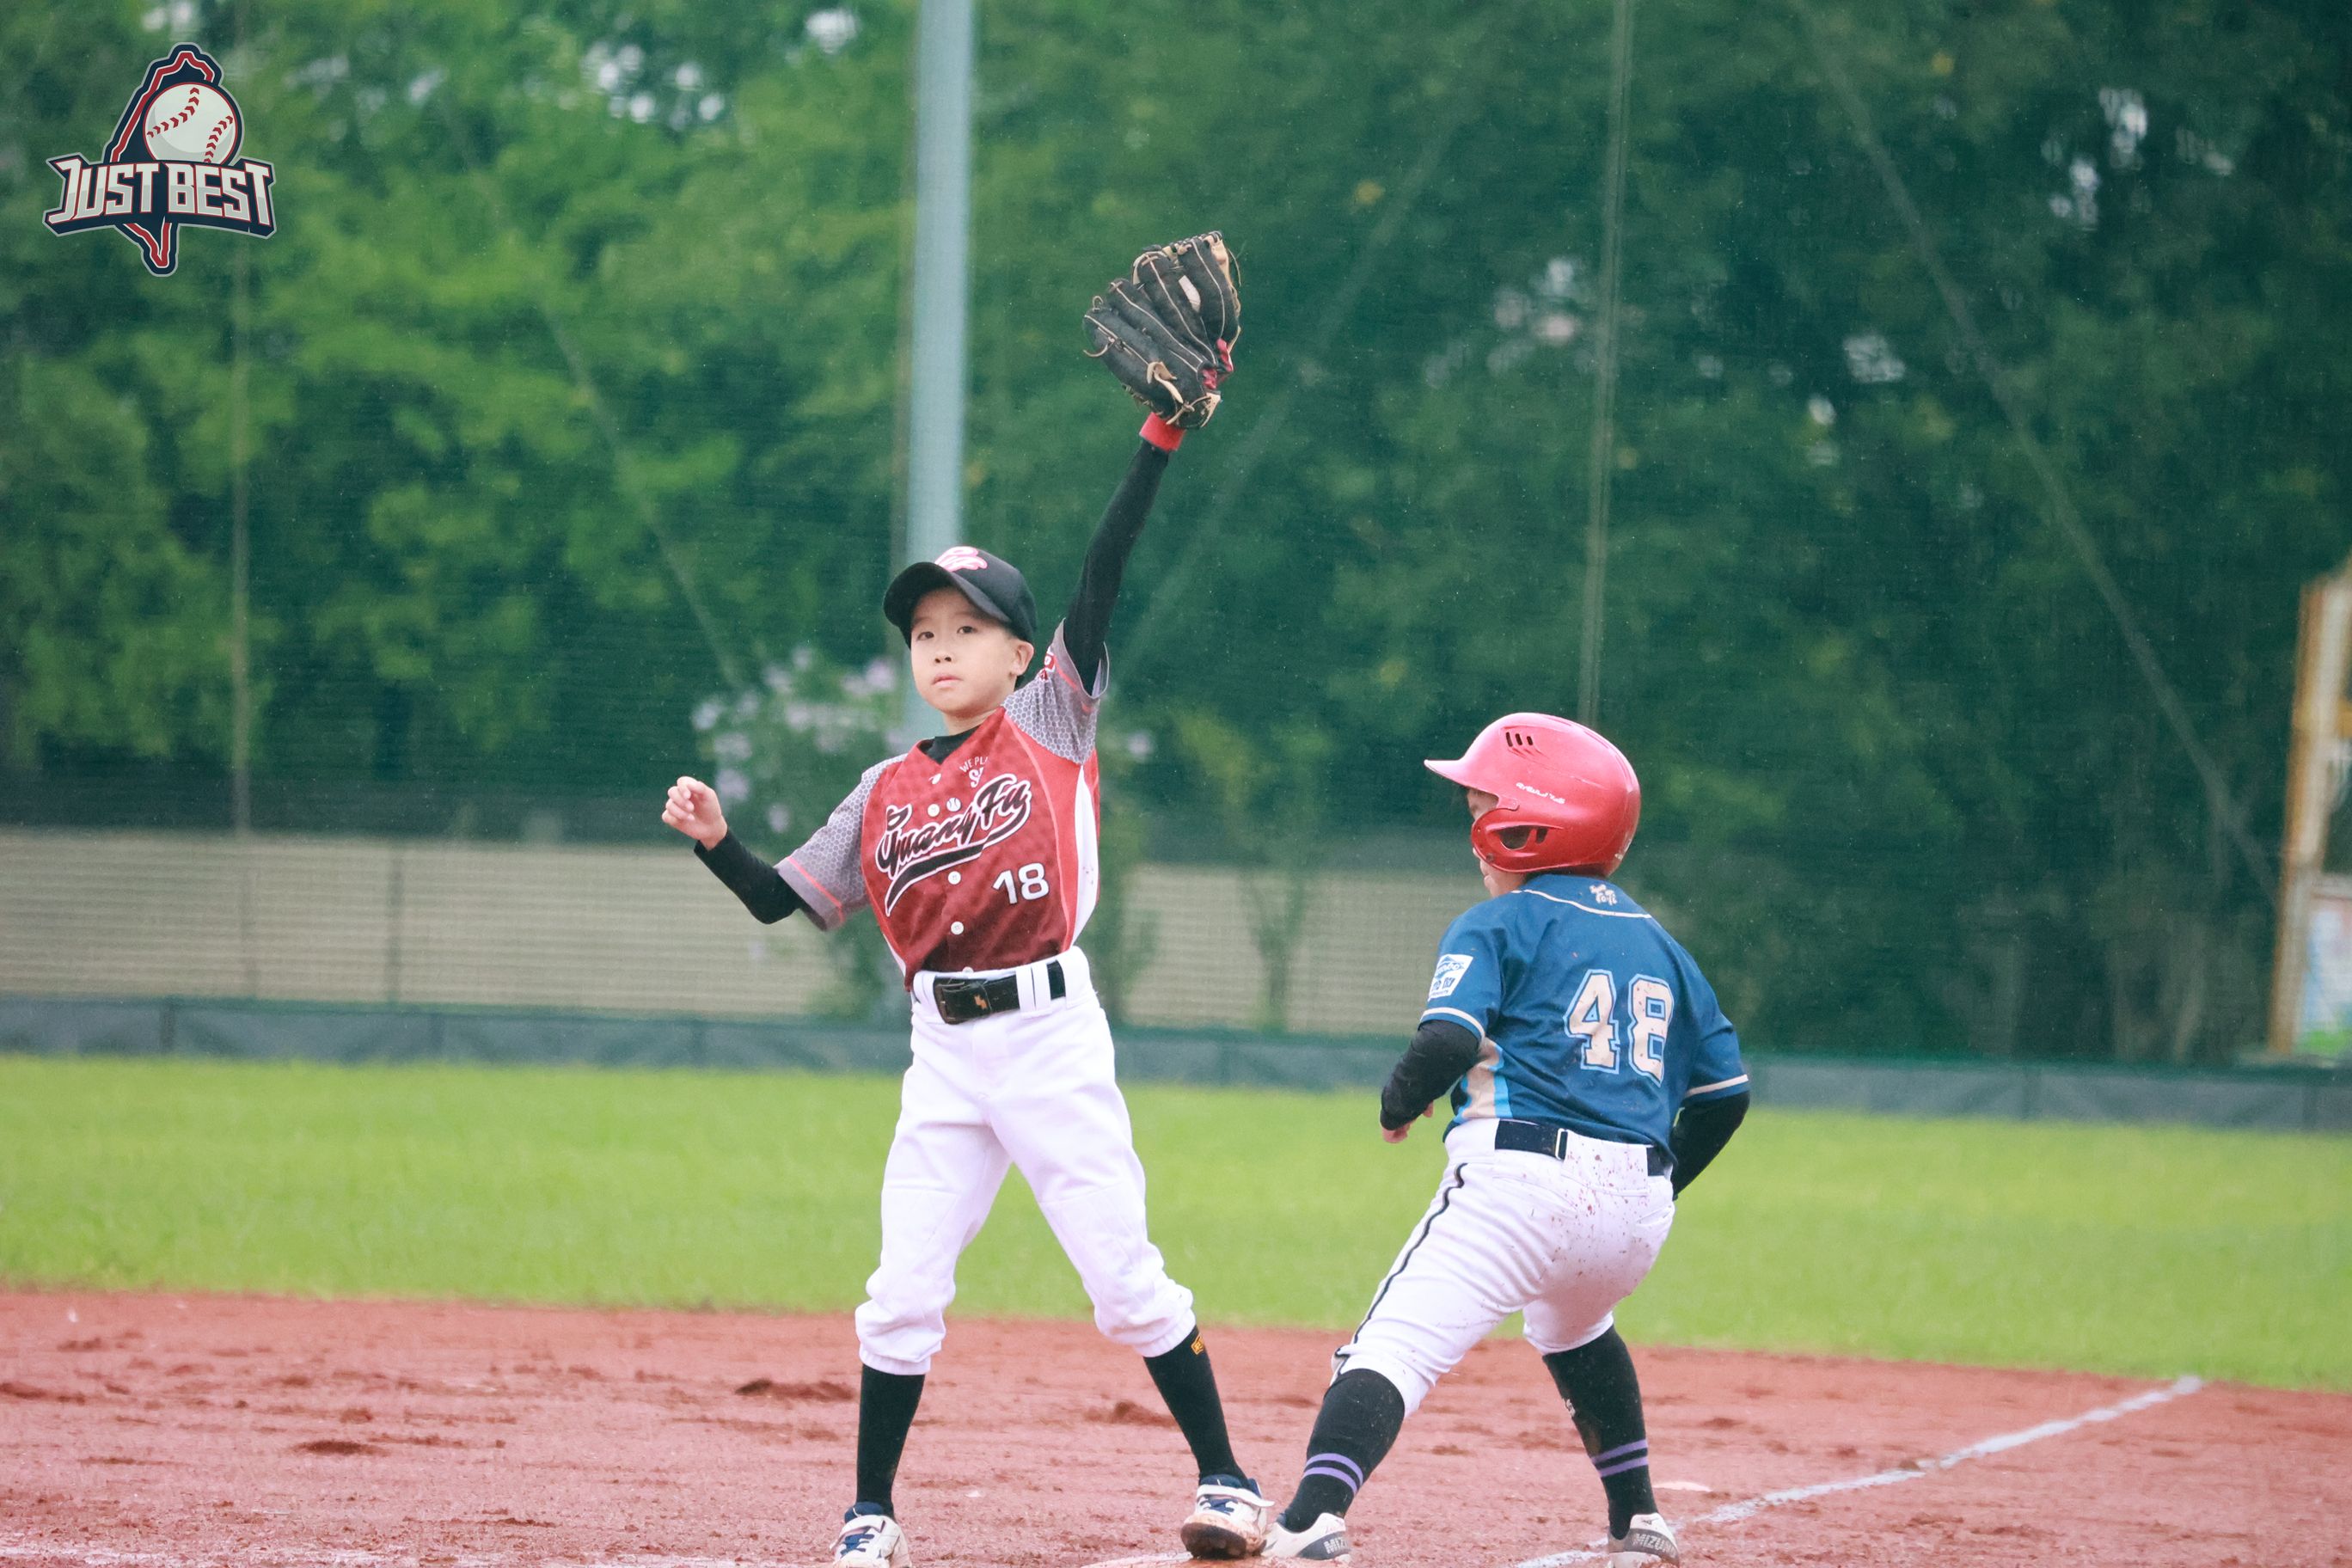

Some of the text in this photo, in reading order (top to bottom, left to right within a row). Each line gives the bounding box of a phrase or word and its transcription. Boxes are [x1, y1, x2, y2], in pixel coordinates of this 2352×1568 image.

[959, 759, 972, 772] WE
[992, 862, 1050, 904] 18
[1562, 969, 1675, 1087] 48
